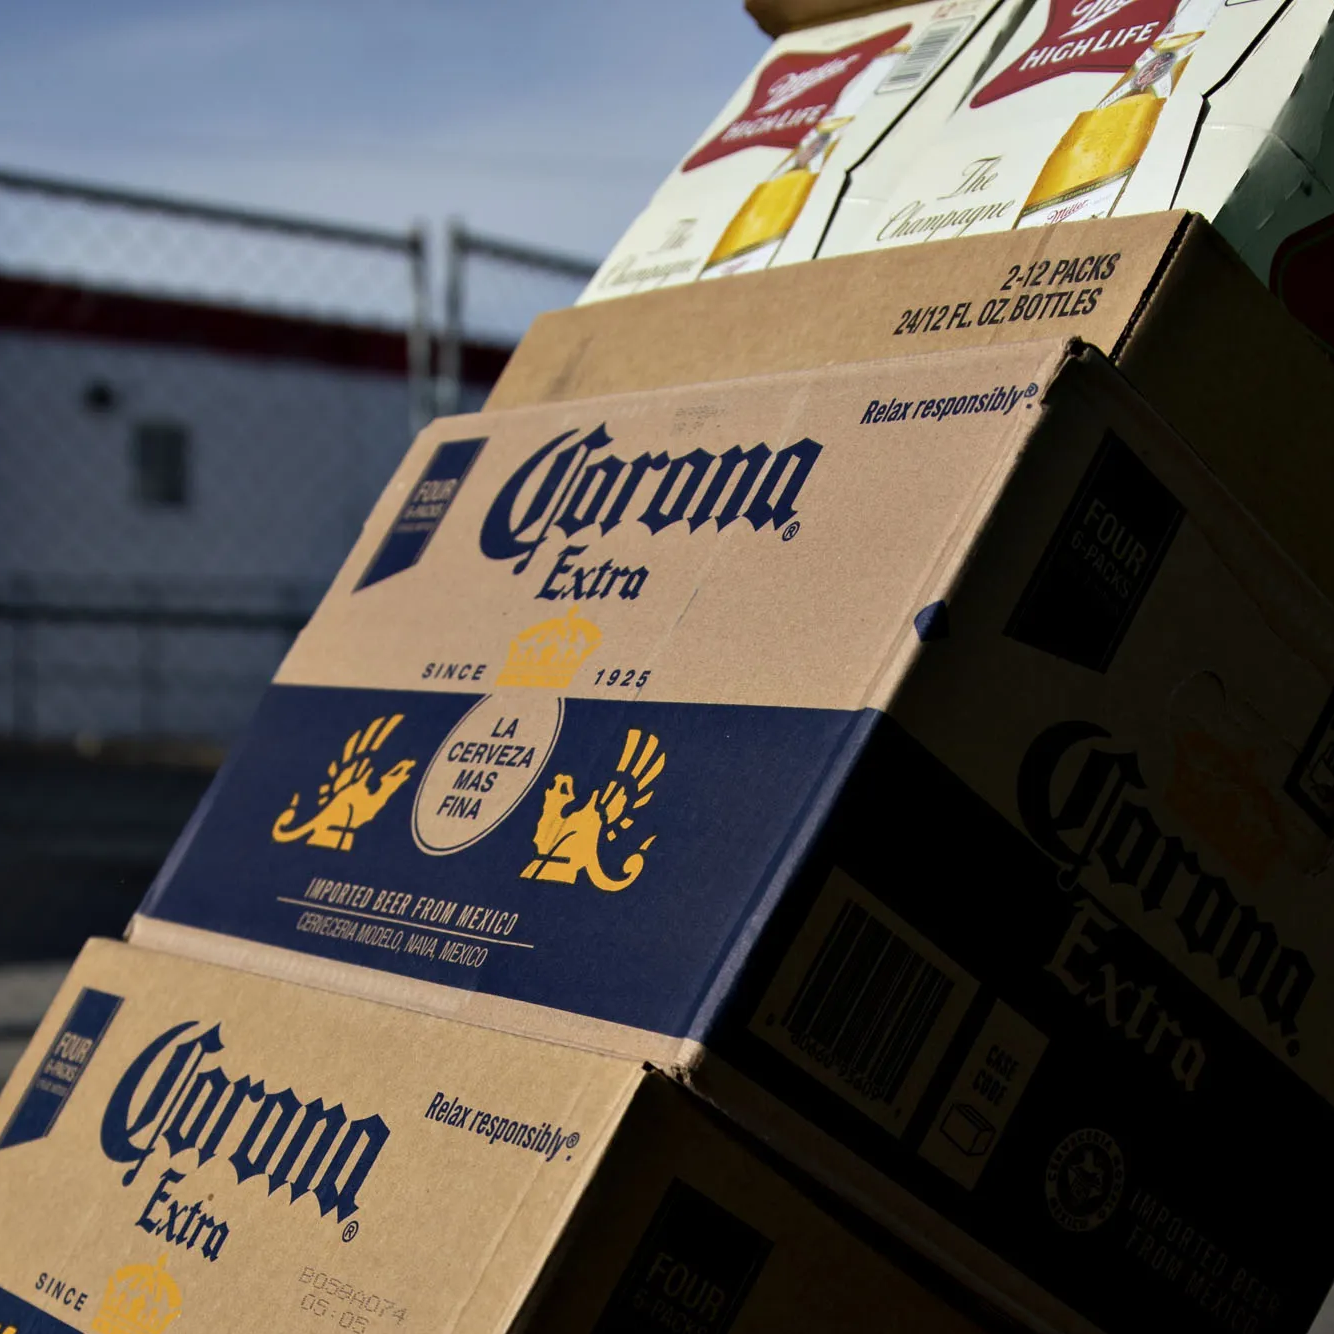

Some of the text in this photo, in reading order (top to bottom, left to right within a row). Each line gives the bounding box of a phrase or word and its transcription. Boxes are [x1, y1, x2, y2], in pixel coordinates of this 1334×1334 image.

[1019, 21, 1160, 72] HIGH LIFE
[938, 155, 1002, 201] The
[876, 199, 1016, 242] Champagne
[1000, 253, 1121, 291] 2-12 PACKS
[893, 304, 951, 336] 24/12
[1007, 287, 1103, 323] BOTTLES
[860, 398, 911, 425] Relax
[1083, 497, 1148, 577] FOUR
[536, 544, 650, 601] Extra
[1071, 530, 1133, 599] 6-PACKS
[422, 661, 652, 689] SINCE 1925
[491, 717, 520, 739] LA
[447, 741, 537, 769] CERVEZA
[452, 770, 498, 793] MAS
[436, 796, 483, 820] FINA
[303, 877, 519, 936] IMPORTED BEER FROM MEXICO
[295, 911, 357, 940] CERVECERIA
[439, 941, 488, 968] MEXICO
[1042, 898, 1207, 1092] Extra
[424, 1091, 468, 1130] Relax
[134, 1167, 230, 1263] Extra
[1128, 1186, 1230, 1278] IMPORTED
[1124, 1222, 1185, 1283] FROM
[35, 1272, 89, 1312] SINCE
[645, 1251, 726, 1322] FOUR
